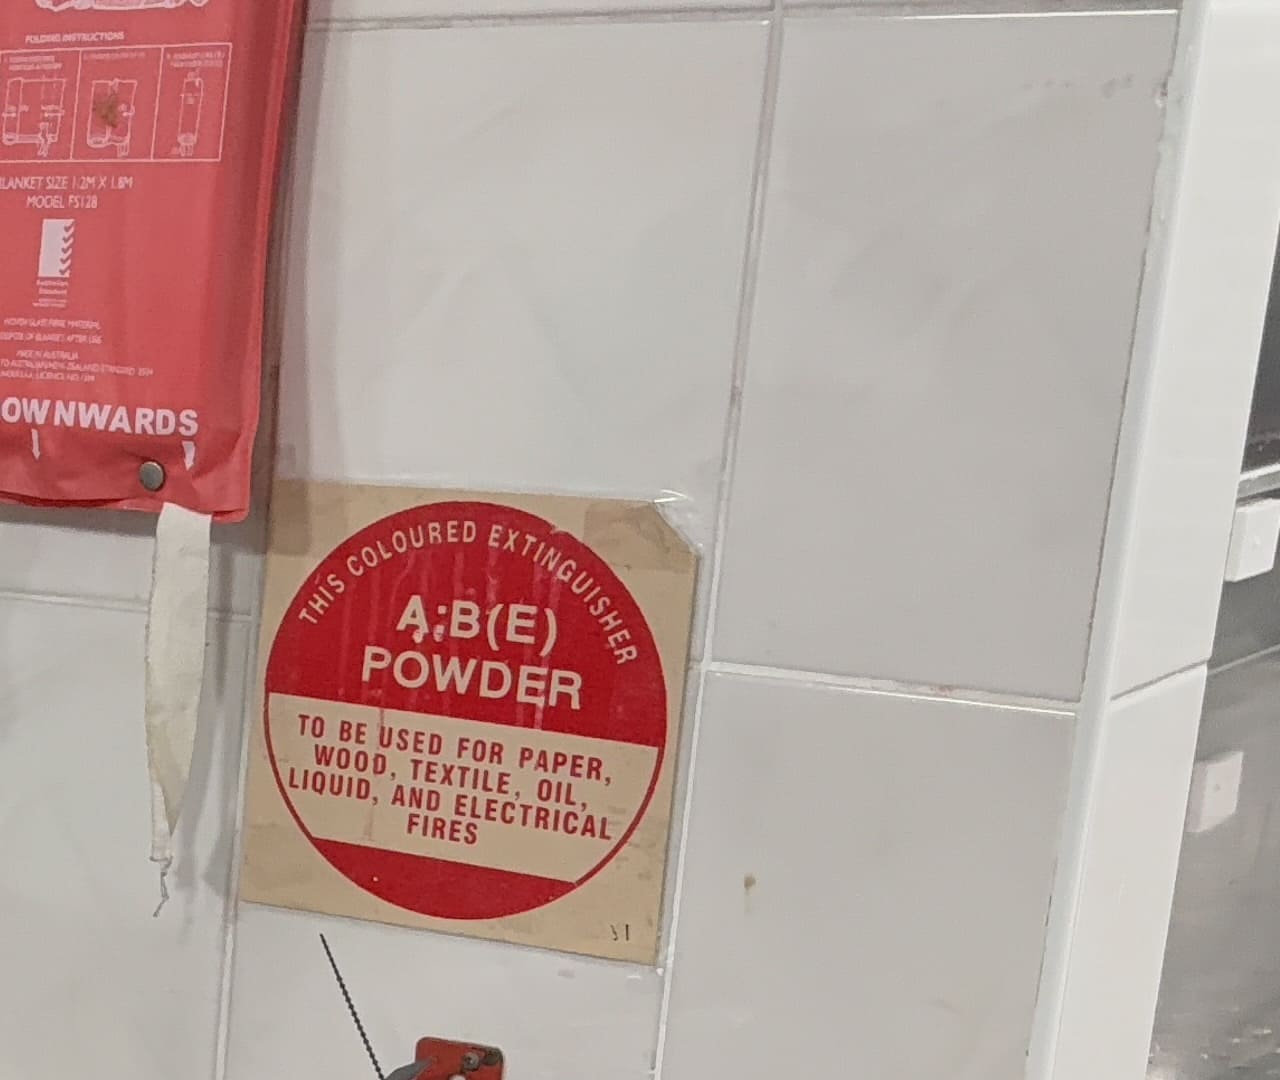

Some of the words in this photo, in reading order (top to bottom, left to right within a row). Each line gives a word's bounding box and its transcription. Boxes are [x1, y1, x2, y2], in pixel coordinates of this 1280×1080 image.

[27, 195, 64, 209] MODEL
[46, 176, 68, 190] SIZE
[99, 177, 106, 189] X
[298, 573, 345, 625] THIS
[348, 520, 478, 576] COLOURED
[489, 526, 639, 666] EXTINGUISHER
[361, 646, 582, 710] POWDER
[297, 714, 325, 739] TO
[339, 721, 367, 745] BE
[378, 726, 443, 756] USED
[456, 737, 504, 765] FOR
[519, 747, 613, 787] PAPER,
[313, 743, 397, 781] WOOD,
[410, 759, 522, 801] TEXTILE,
[537, 779, 588, 812] OIL,
[288, 766, 380, 806] LIQUID,
[391, 785, 441, 812] AND
[454, 799, 613, 841] ELECTRICAL
[406, 814, 479, 845] FIRES
